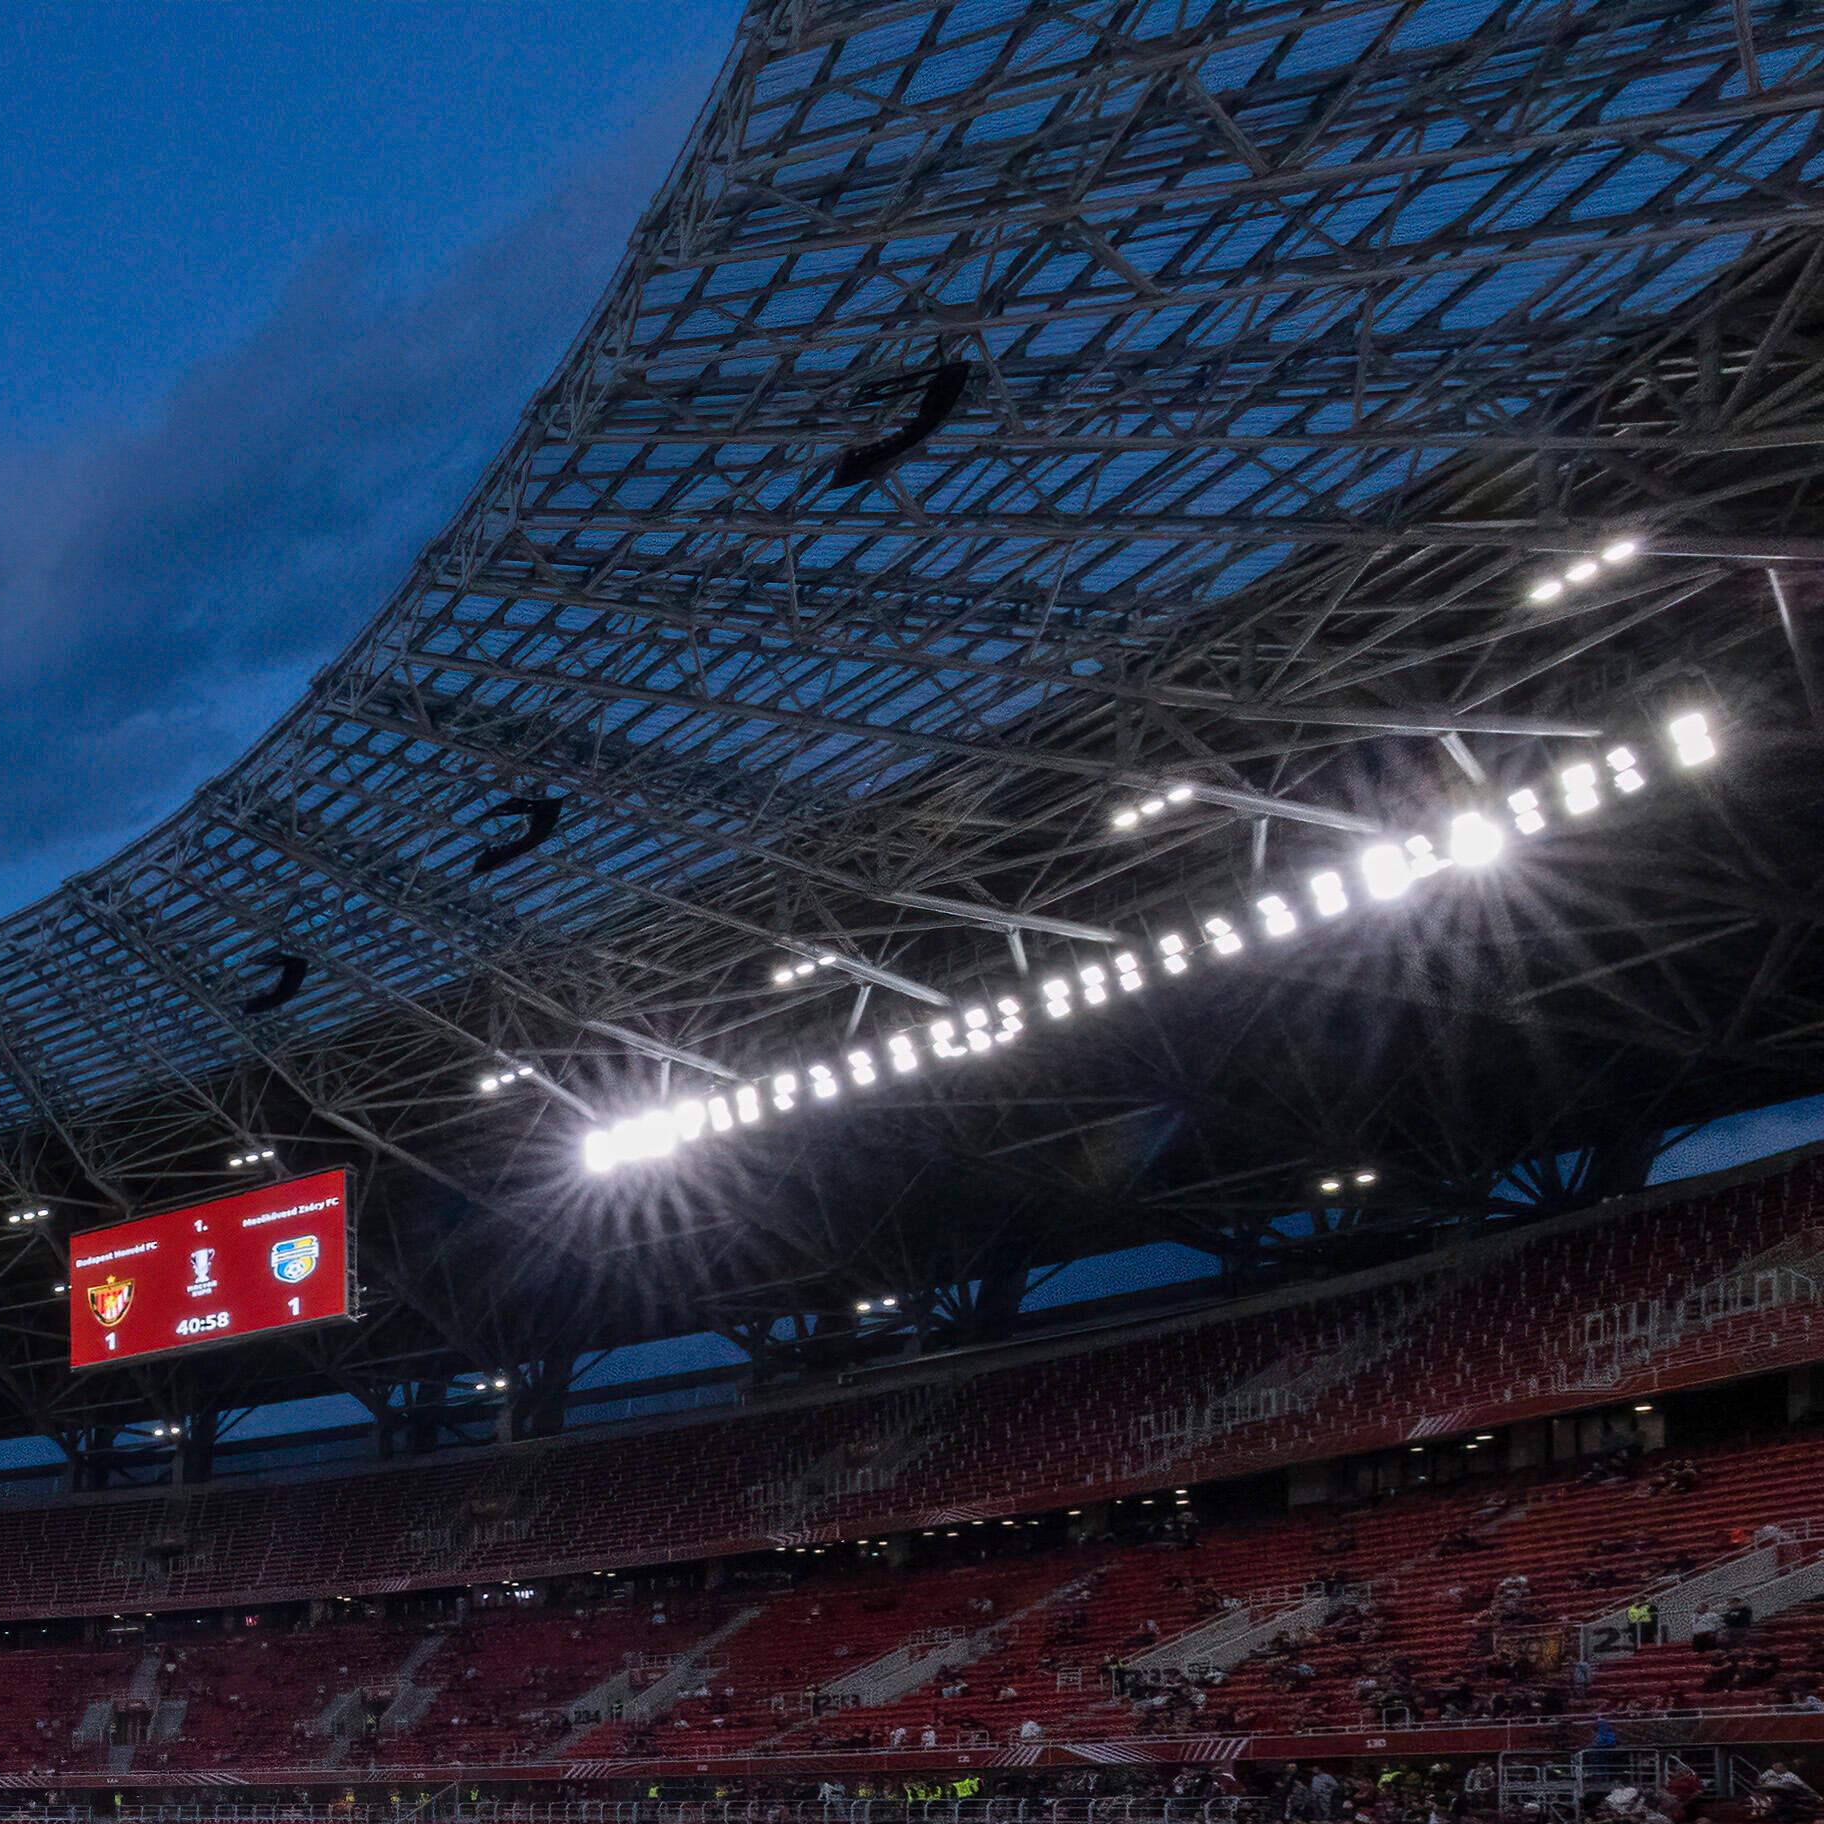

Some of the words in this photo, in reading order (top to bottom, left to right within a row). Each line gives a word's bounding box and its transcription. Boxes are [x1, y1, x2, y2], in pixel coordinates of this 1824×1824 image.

[325, 1197, 340, 1207] FC
[194, 1219, 208, 1232] 1.
[145, 1241, 158, 1251] FC
[287, 1297, 300, 1316] 1
[175, 1311, 231, 1336] 40:58
[104, 1331, 117, 1350] 1
